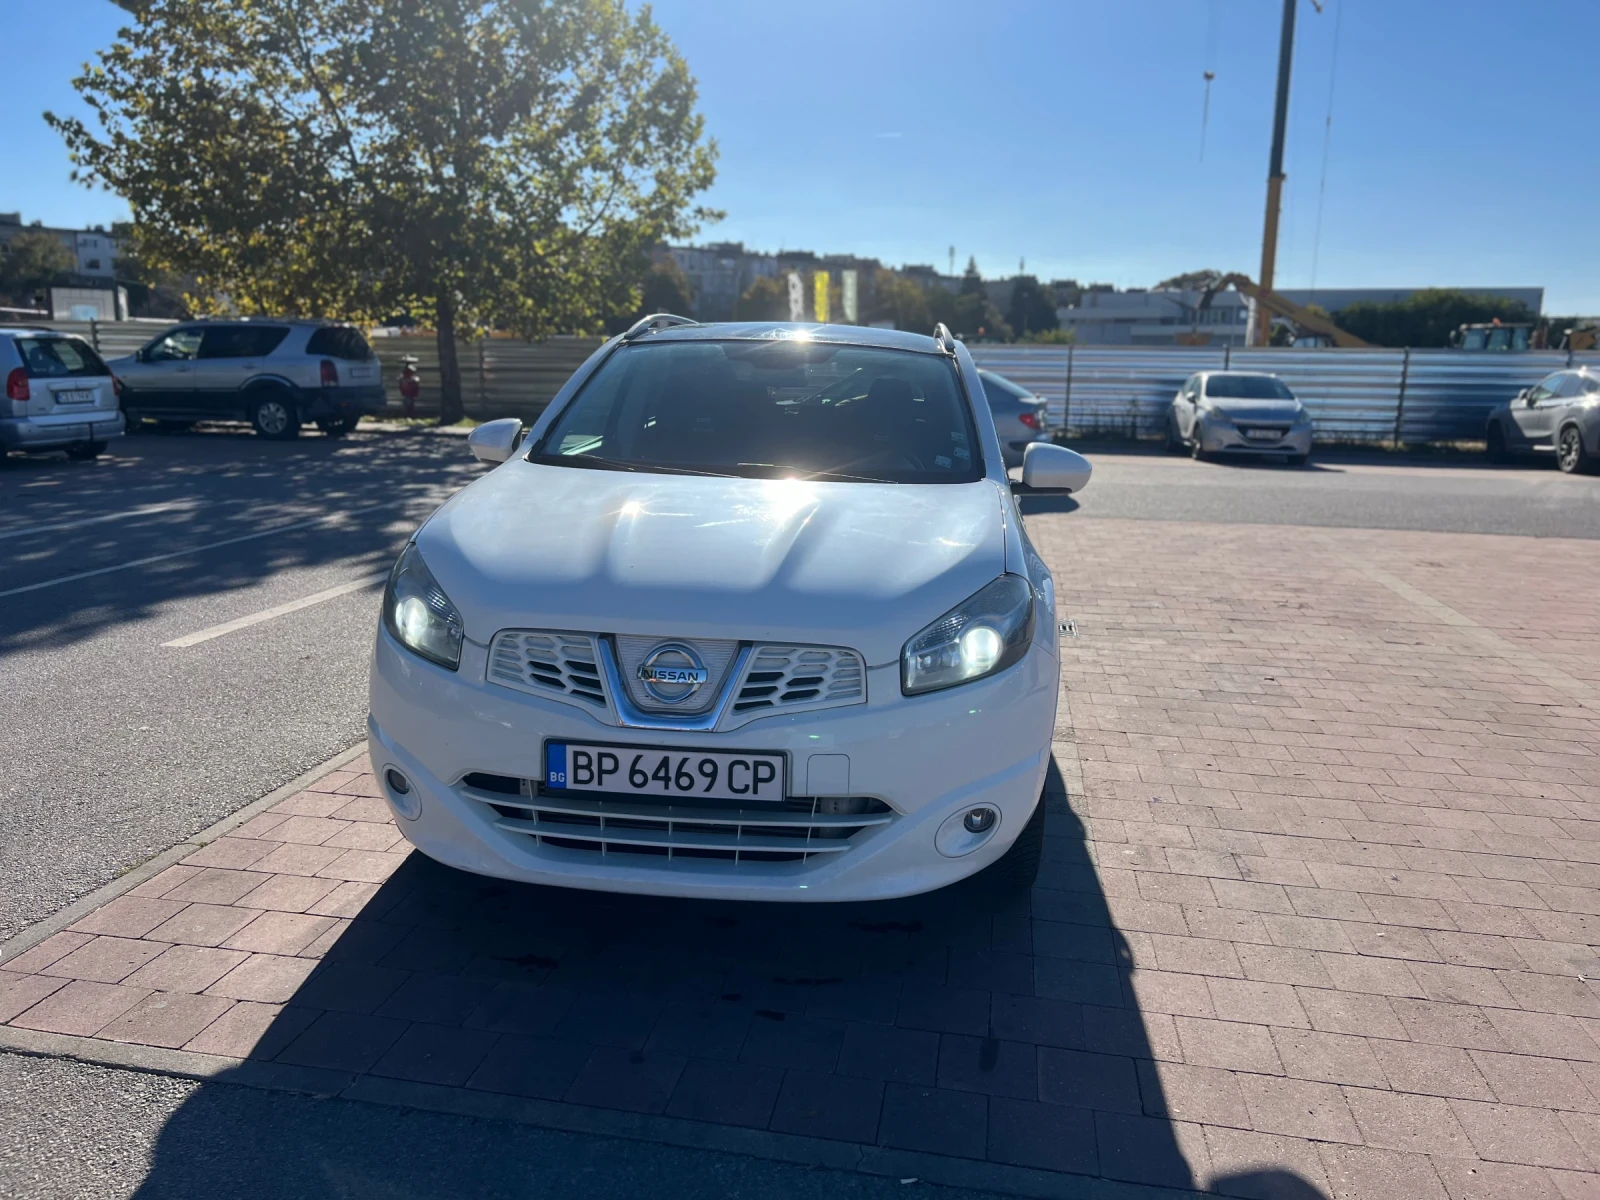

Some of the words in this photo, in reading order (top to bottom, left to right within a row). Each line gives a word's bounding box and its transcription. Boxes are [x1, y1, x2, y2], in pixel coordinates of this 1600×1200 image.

[642, 669, 699, 681] NISSAN
[550, 771, 565, 783] BG
[572, 750, 619, 786] BP
[628, 754, 719, 793] 6469
[727, 759, 776, 795] CP
